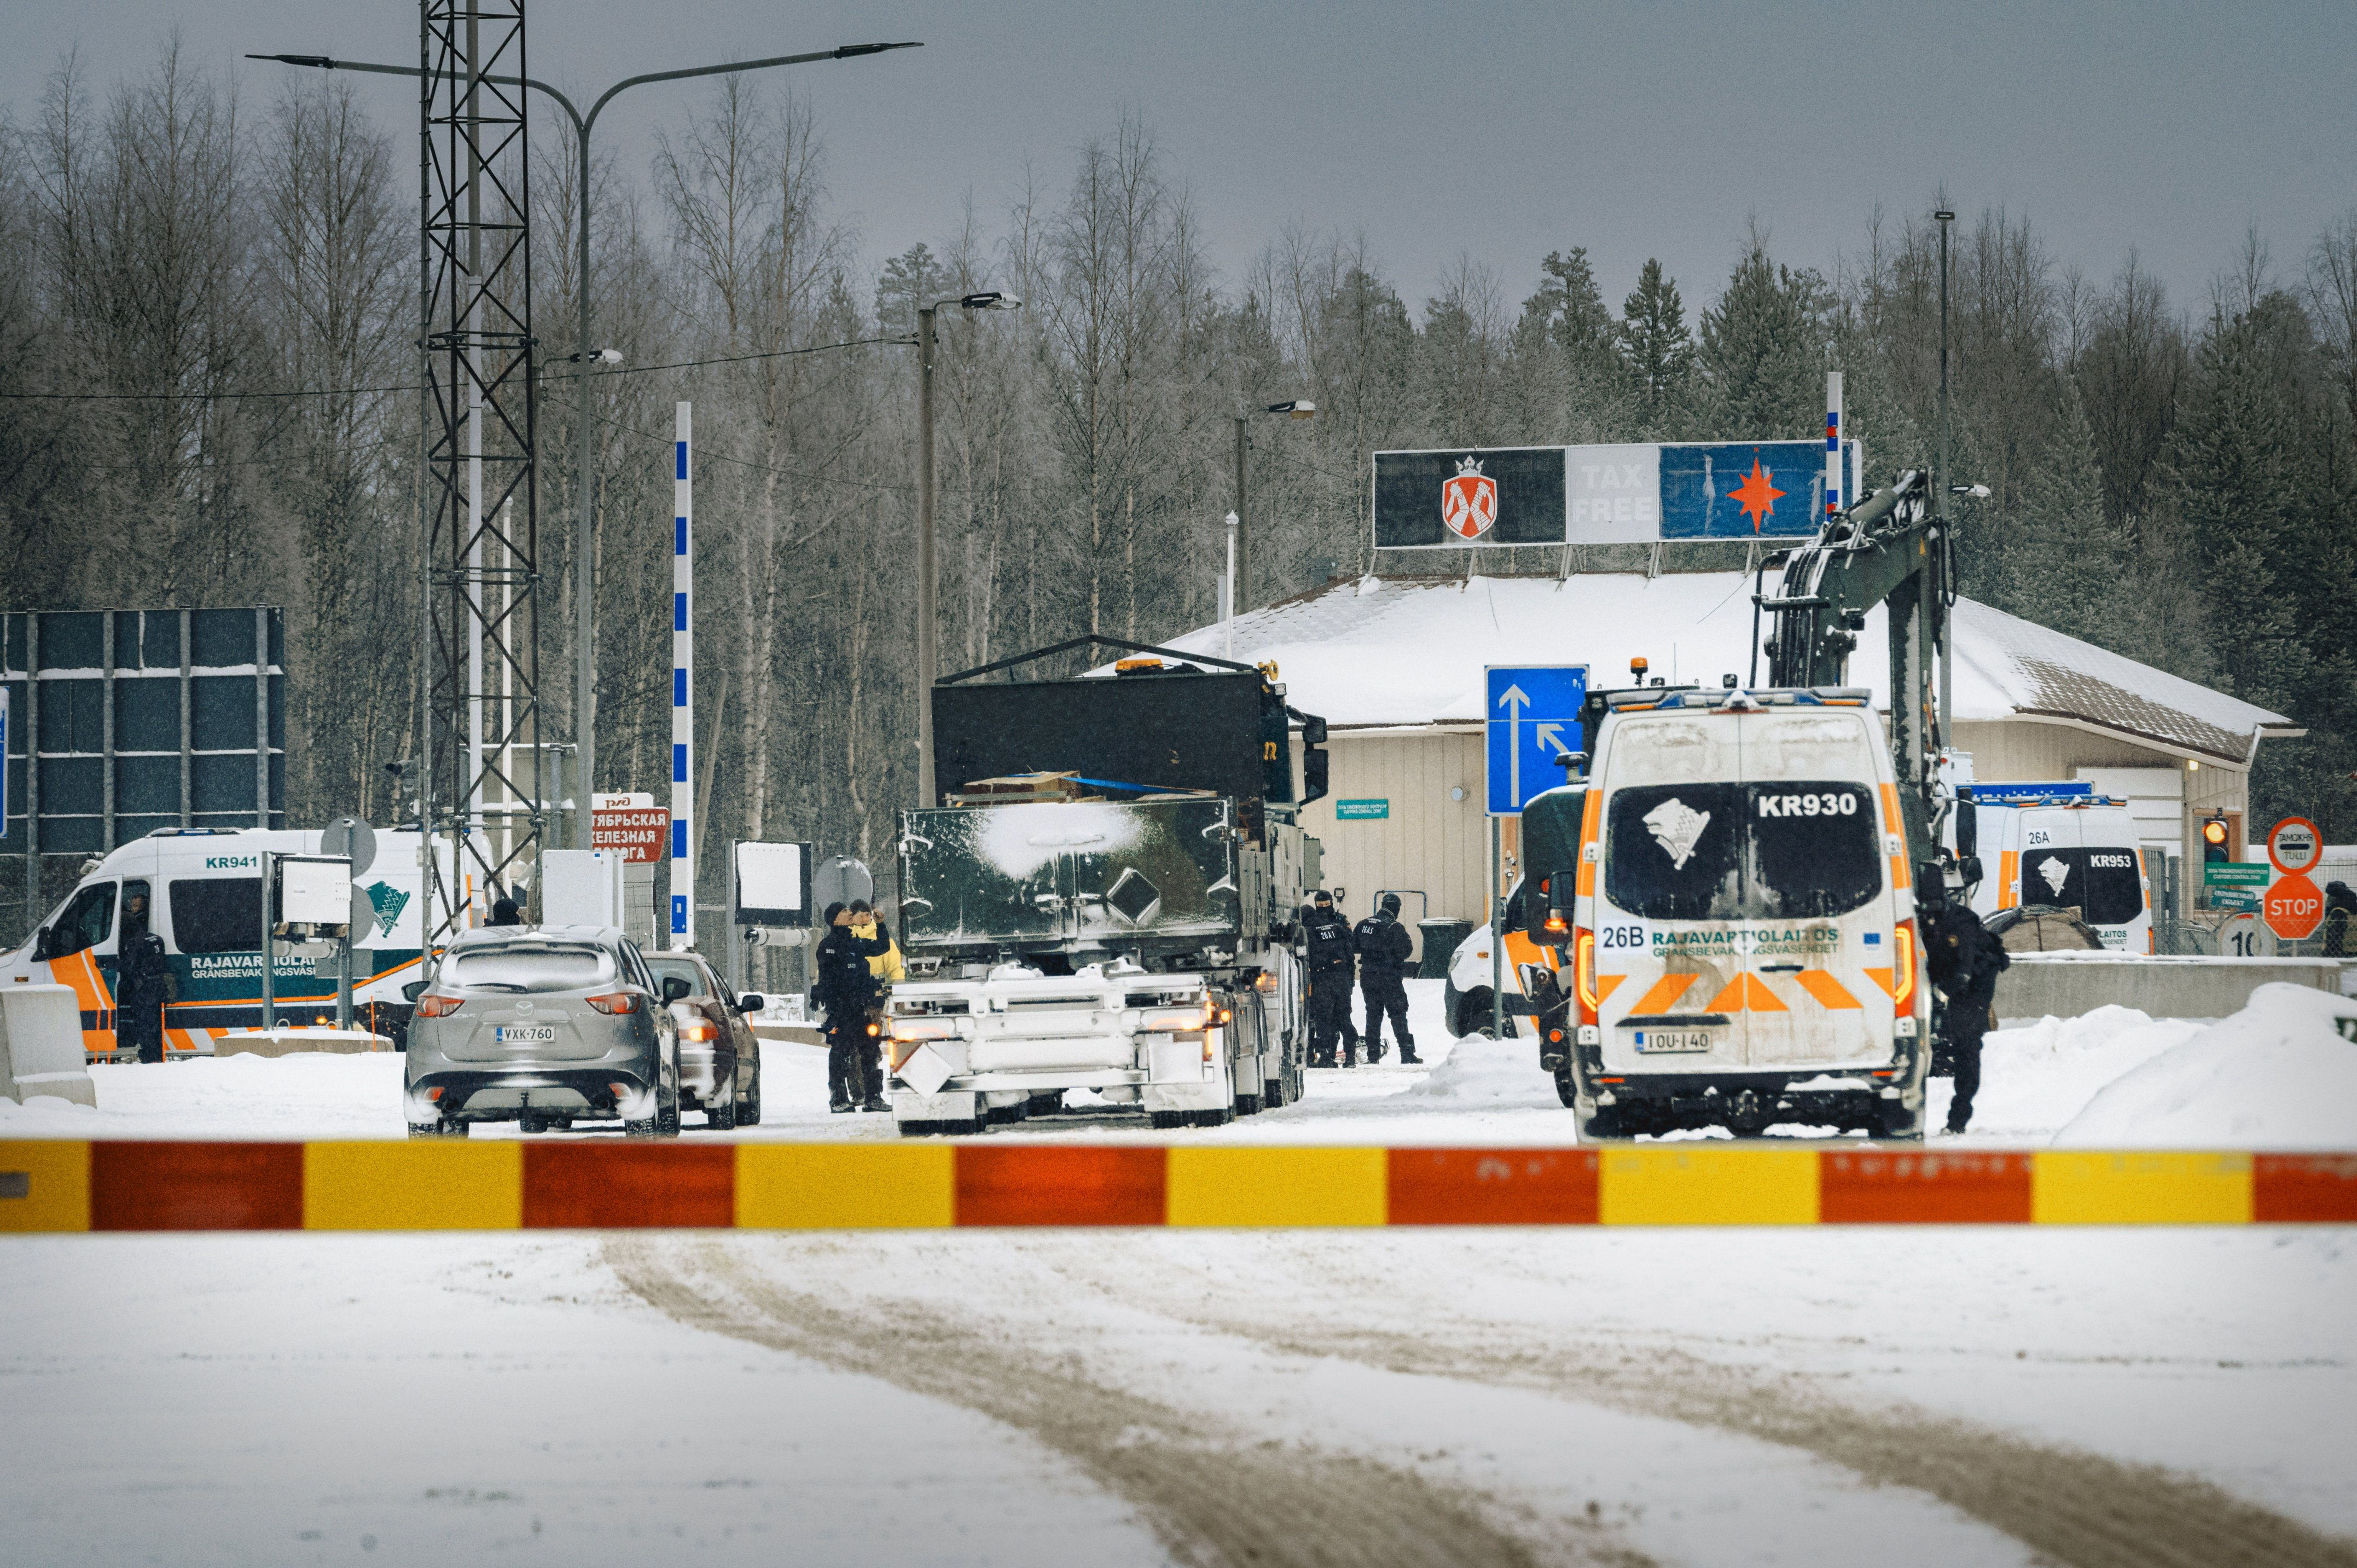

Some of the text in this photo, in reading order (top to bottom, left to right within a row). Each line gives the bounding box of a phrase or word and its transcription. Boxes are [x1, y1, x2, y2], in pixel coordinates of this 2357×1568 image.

[1580, 464, 1643, 489] TAX
[1573, 497, 1653, 522] FREE
[1759, 793, 1857, 817] KR930
[592, 814, 666, 827] ТЯБРЬСКАЯ
[2028, 831, 2050, 845] 26A
[206, 856, 257, 869] KR941
[2090, 855, 2131, 868] KR953
[2270, 899, 2318, 915] STOP
[1321, 931, 1335, 939] 26A1
[1362, 925, 1374, 935] 26A5
[1602, 926, 1644, 949] 26B
[505, 1029, 552, 1039] VXK-760
